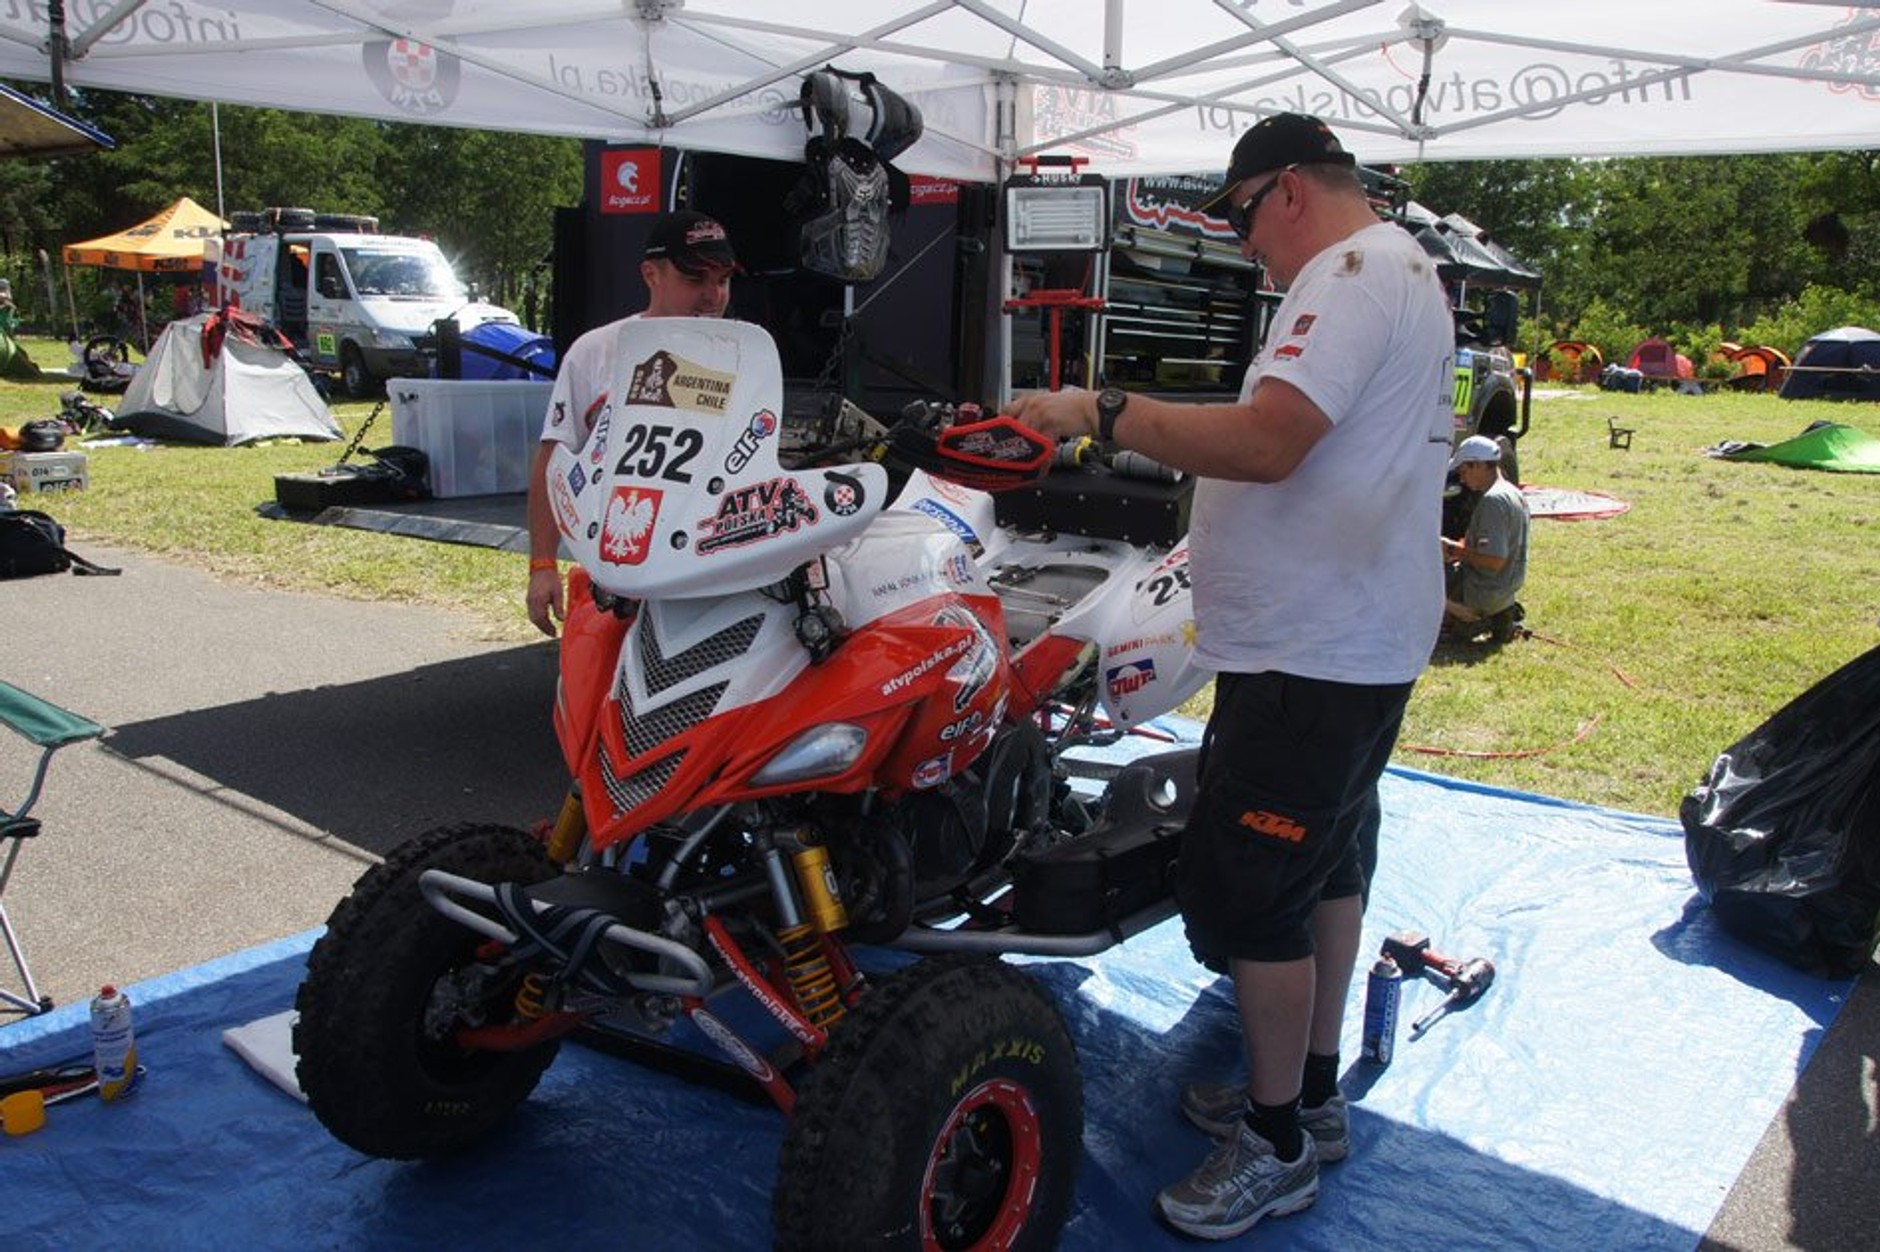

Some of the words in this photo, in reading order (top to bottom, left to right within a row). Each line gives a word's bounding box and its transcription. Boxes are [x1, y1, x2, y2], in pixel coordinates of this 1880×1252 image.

[1041, 174, 1082, 184] HUSKY
[673, 373, 732, 395] ARGENTINA
[696, 392, 727, 410] CHILE
[614, 423, 704, 484] 252
[724, 427, 764, 475] elf
[717, 480, 781, 520] ATV
[715, 508, 767, 534] POLSKA
[880, 634, 973, 697] atvpolska.pl
[1240, 811, 1307, 842] KTM
[951, 1041, 1046, 1096] MAXXIS
